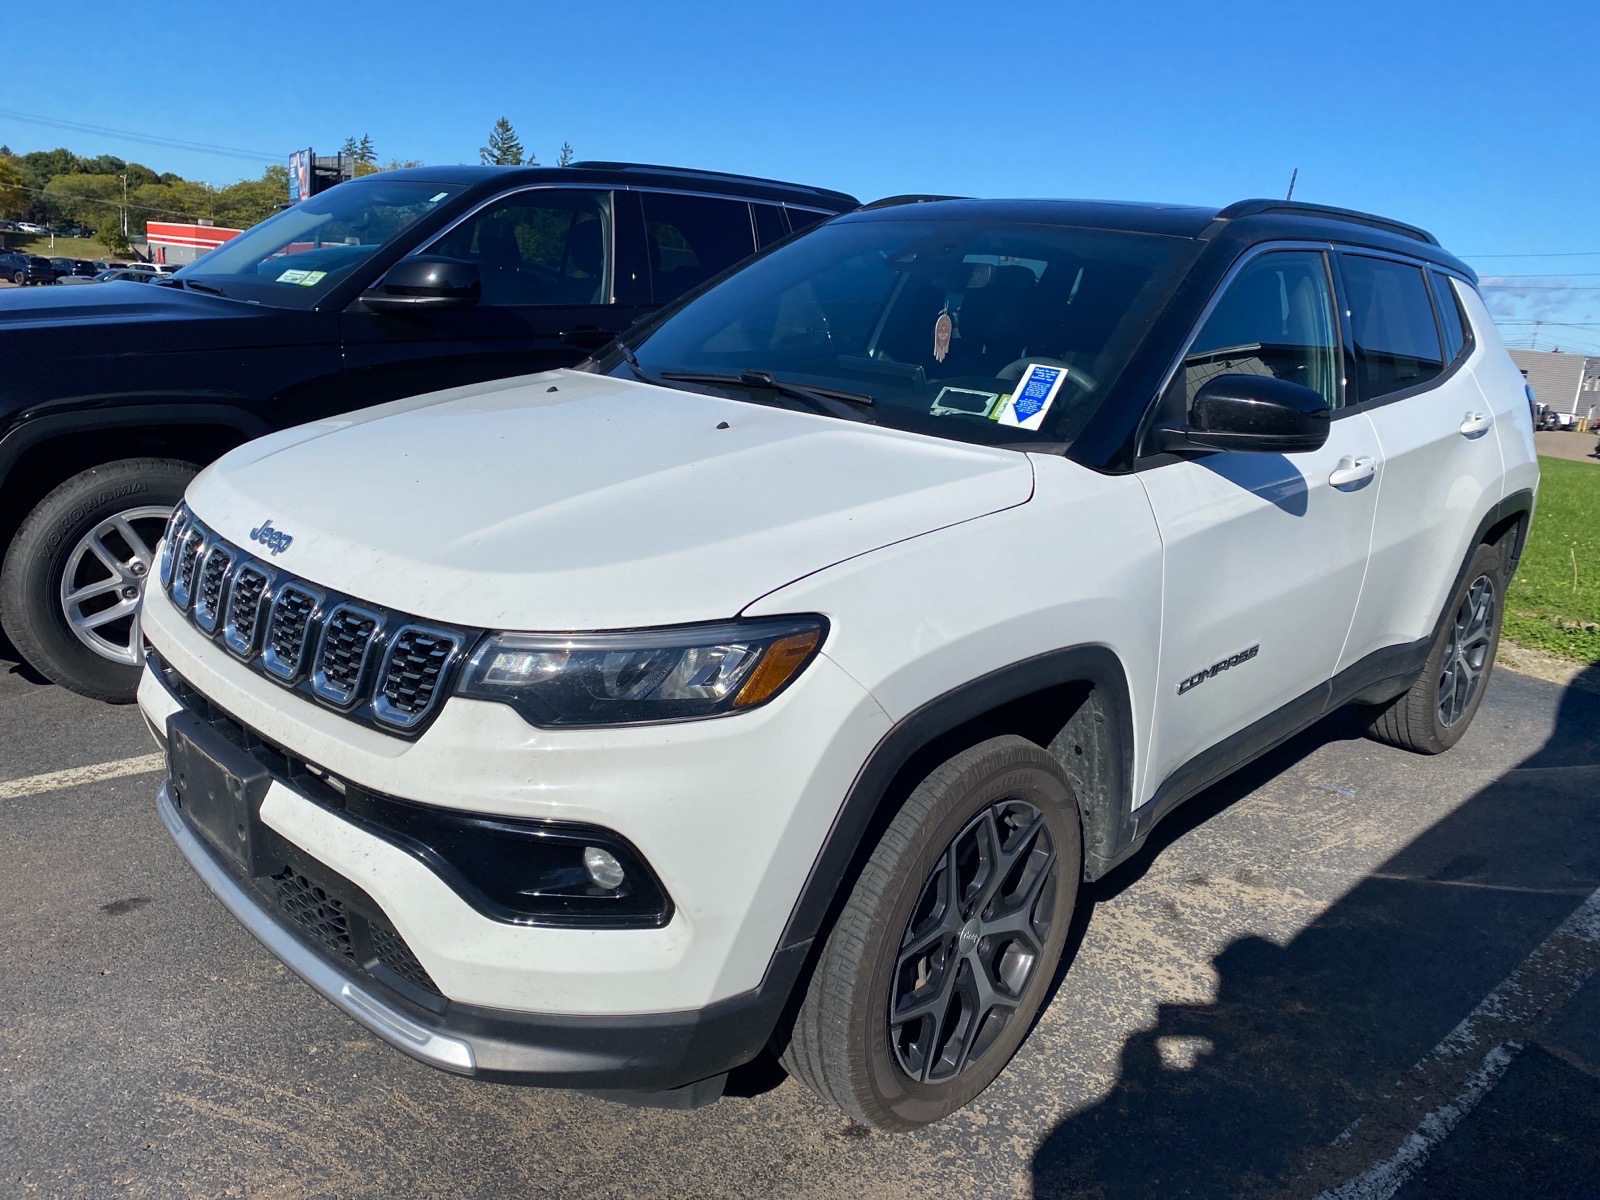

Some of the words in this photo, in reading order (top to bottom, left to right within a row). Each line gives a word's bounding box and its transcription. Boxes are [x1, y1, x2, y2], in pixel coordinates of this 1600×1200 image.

[39, 481, 148, 557] YOKOHAMA
[250, 519, 293, 556] Jeep
[1177, 644, 1259, 695] COMPASS
